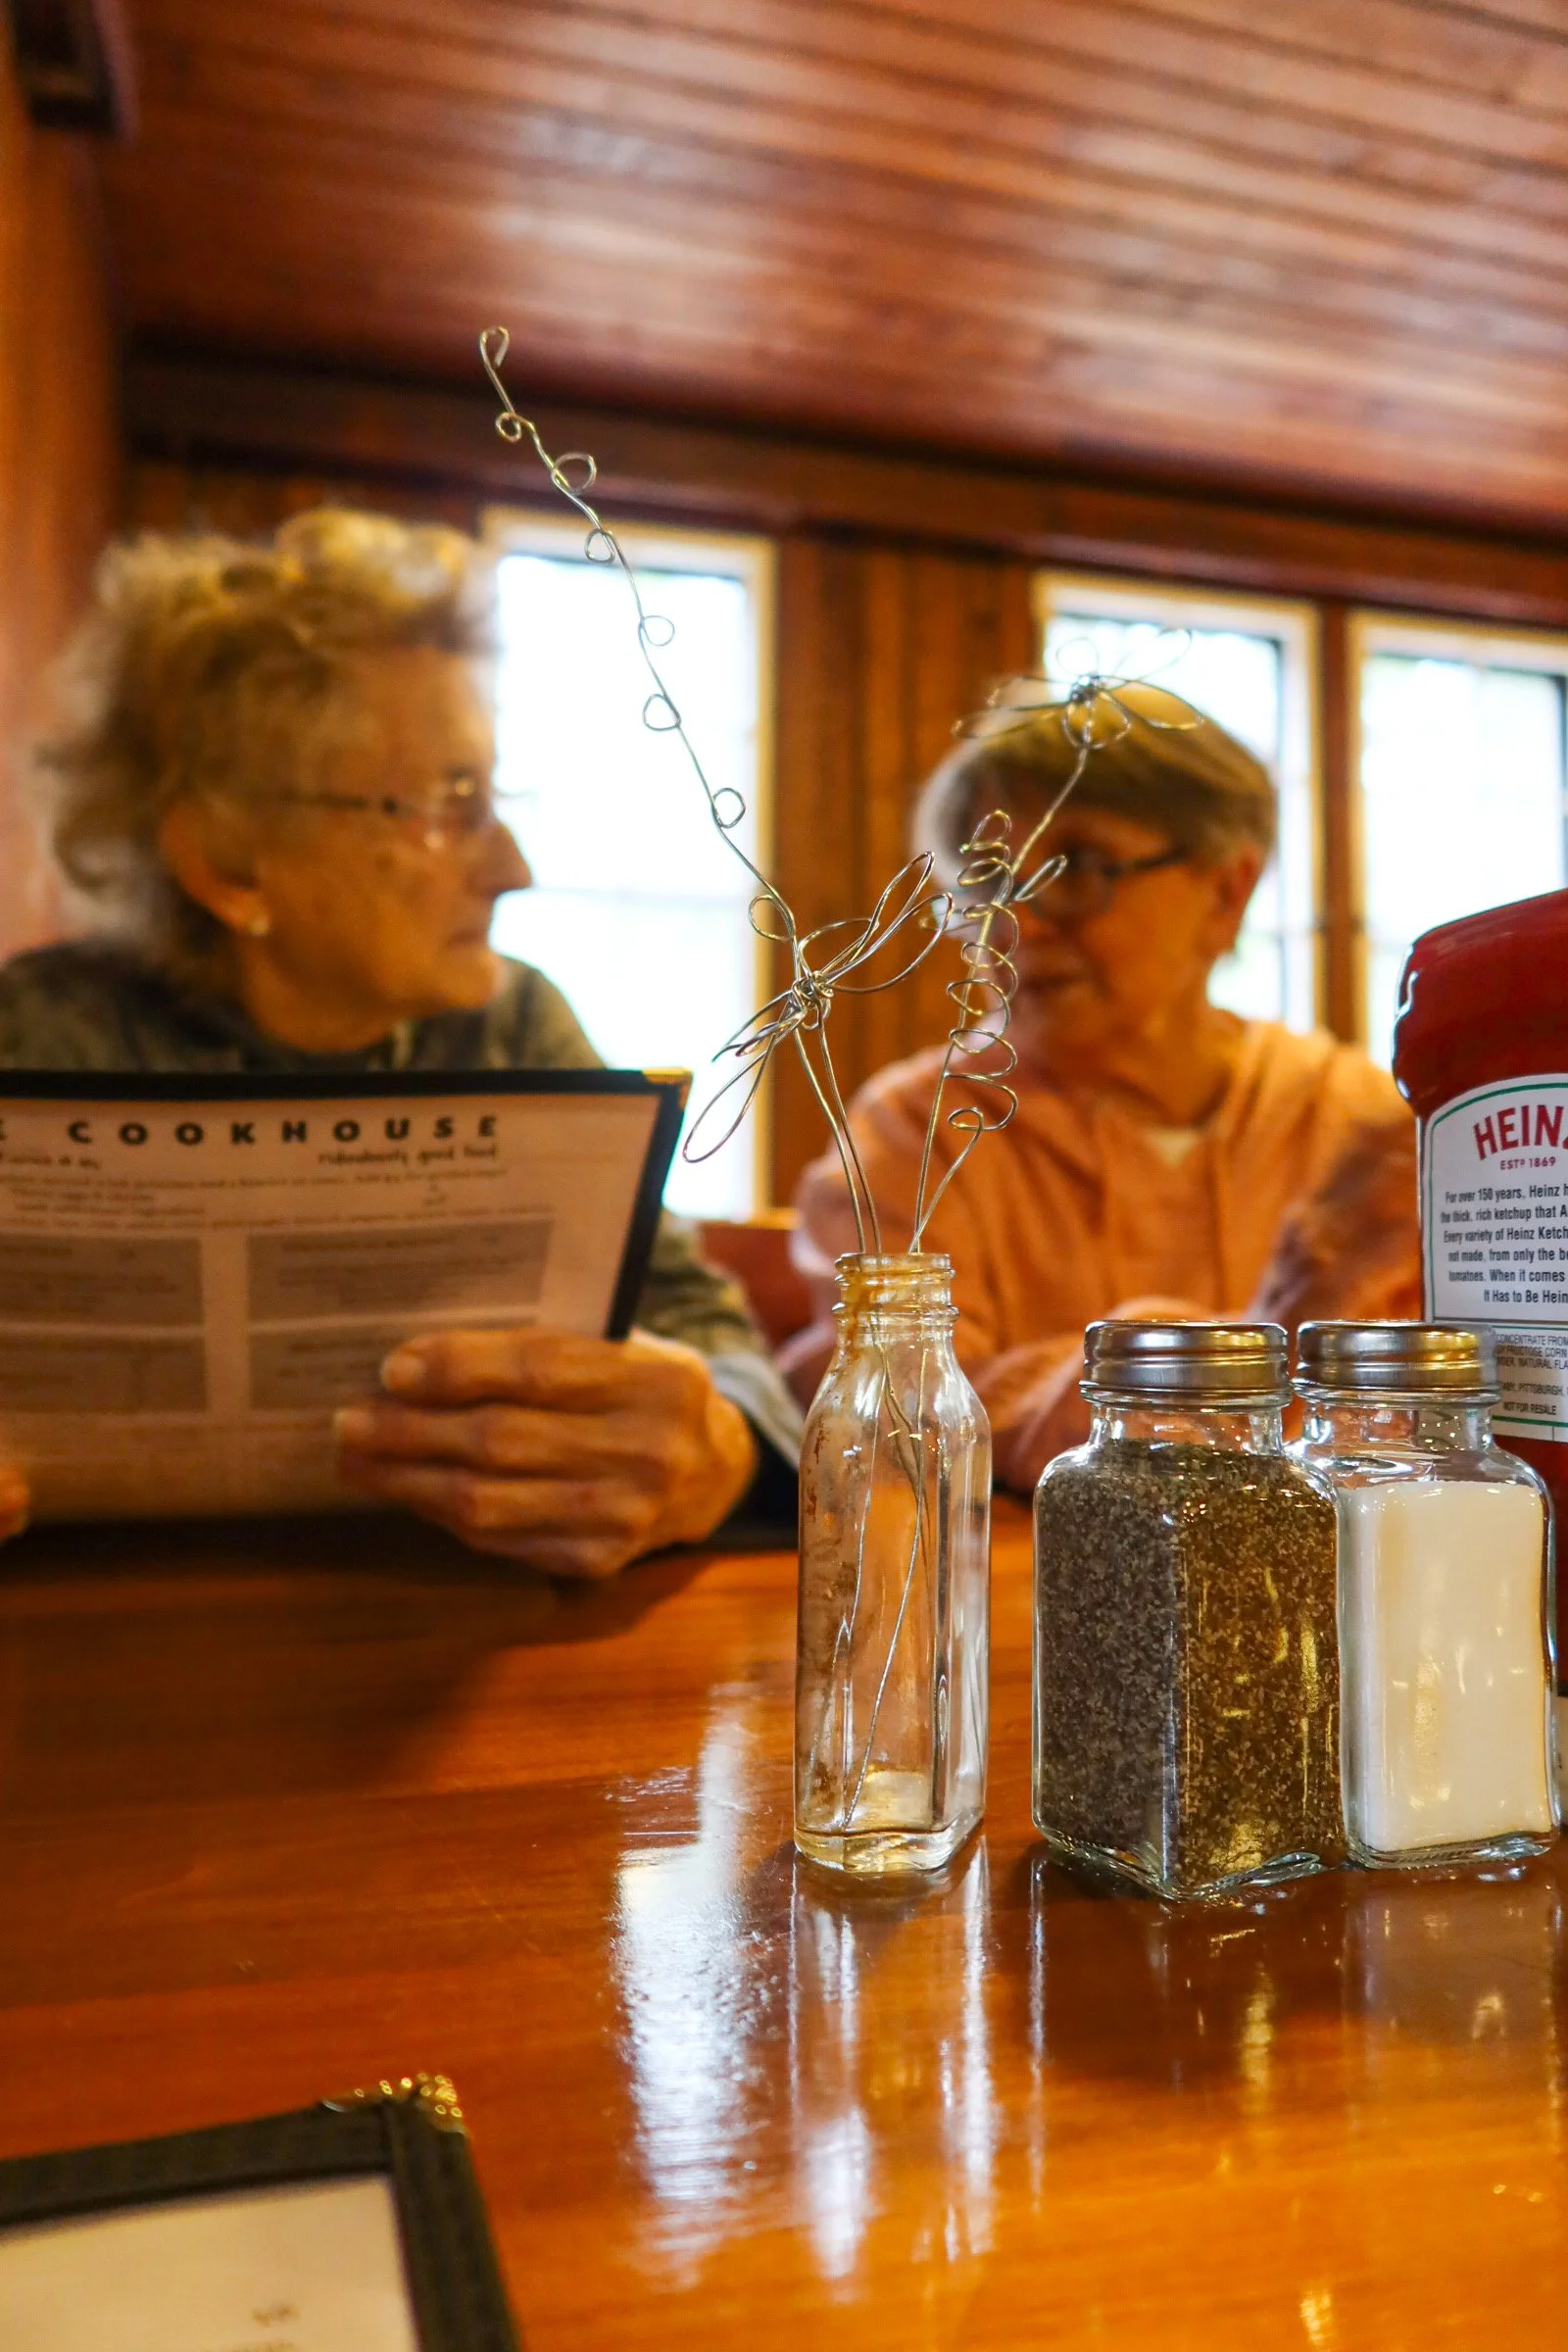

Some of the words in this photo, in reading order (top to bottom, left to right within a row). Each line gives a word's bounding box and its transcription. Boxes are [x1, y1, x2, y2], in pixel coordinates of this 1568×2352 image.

[69, 1116, 497, 1147] COOKHOUSE
[1474, 1104, 1568, 1160] HEIN
[1529, 1156, 1556, 1168] 1869
[1446, 1192, 1457, 1203] For
[1458, 1192, 1475, 1202] over
[1478, 1188, 1493, 1200] 150
[1529, 1185, 1560, 1198] Heinz
[1476, 1208, 1492, 1221] rich
[1494, 1206, 1532, 1222] ketchup
[1535, 1204, 1556, 1218] that
[1444, 1230, 1462, 1245] Every
[1465, 1229, 1493, 1244] variety
[1495, 1228, 1504, 1241] of
[1506, 1227, 1535, 1240] Heinz
[1489, 1249, 1510, 1261] from
[1513, 1249, 1535, 1263] only
[1538, 1248, 1555, 1260] the
[1490, 1269, 1516, 1282] When
[1519, 1269, 1526, 1282] it
[1529, 1271, 1565, 1282] comes
[1484, 1290, 1491, 1301] It
[1493, 1290, 1509, 1302] Has
[1512, 1290, 1522, 1302] to
[1525, 1290, 1539, 1303] Be
